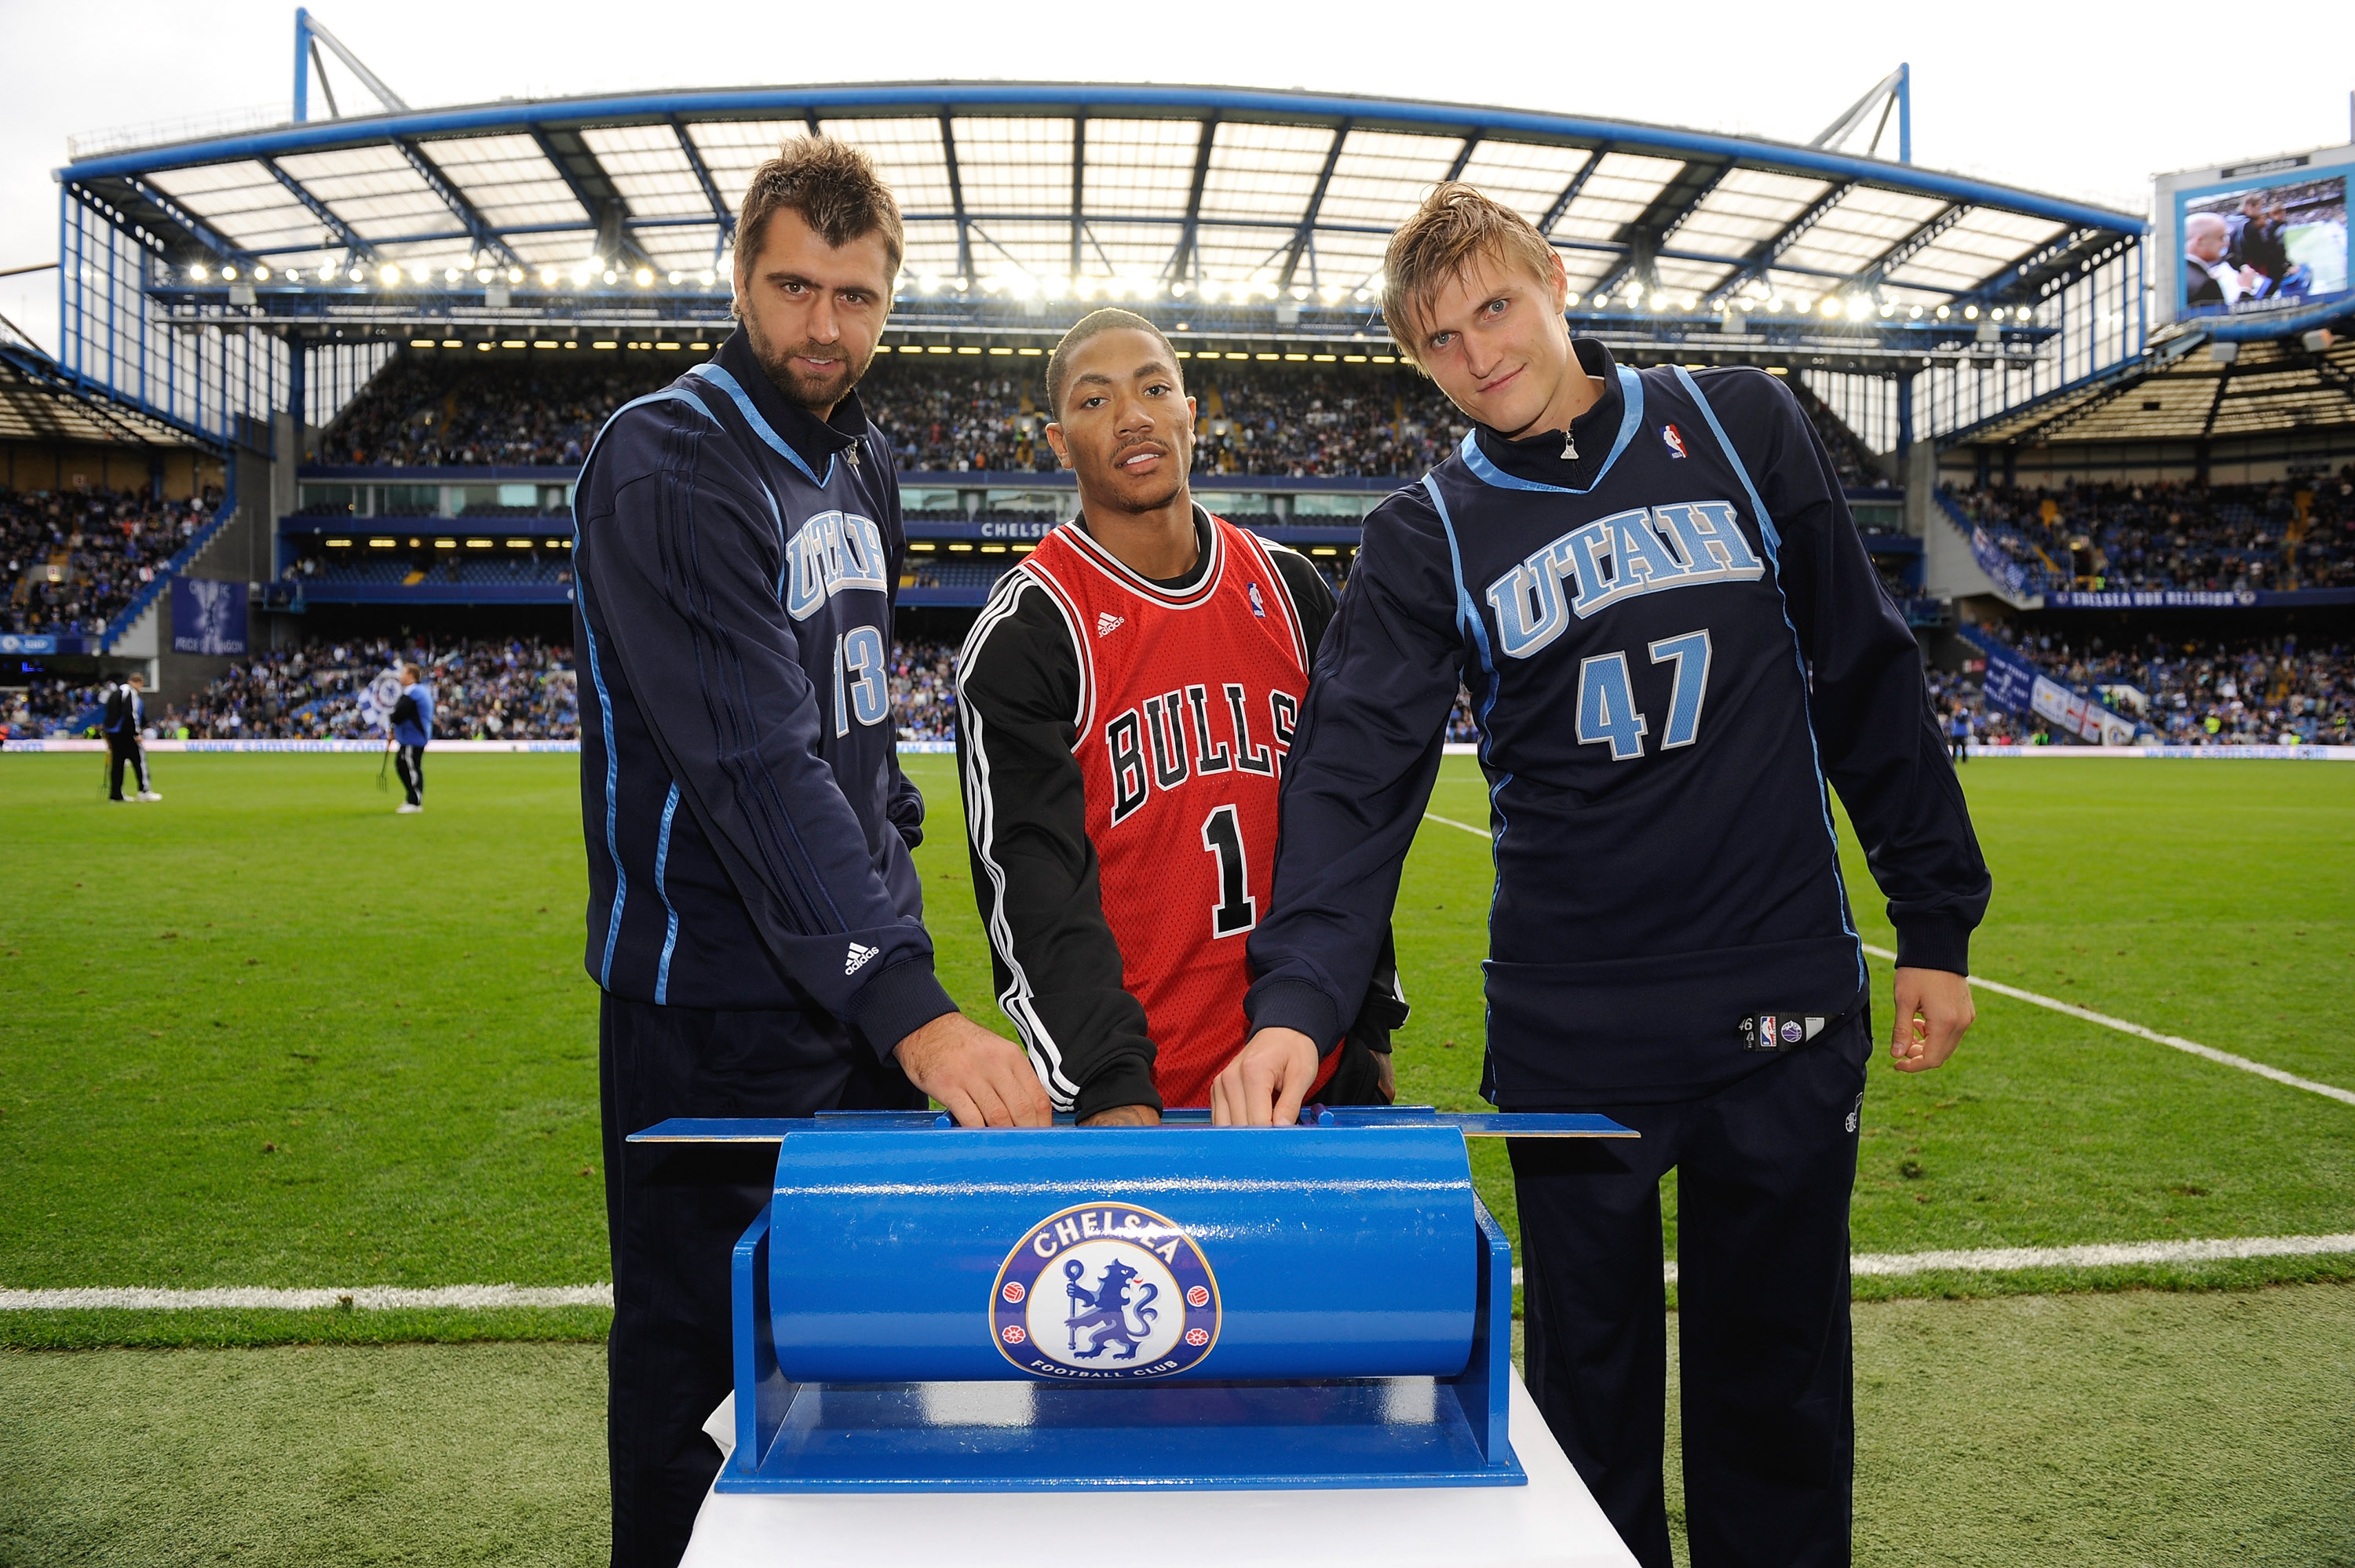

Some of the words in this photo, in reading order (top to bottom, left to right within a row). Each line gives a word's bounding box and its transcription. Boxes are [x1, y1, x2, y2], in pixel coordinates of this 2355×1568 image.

[786, 510, 888, 622] UTAH
[981, 523, 1061, 538] CHELSE
[1486, 501, 1766, 659] UTAH
[834, 625, 889, 739] 13
[1575, 629, 1713, 761] 47
[1105, 683, 1298, 830] BULLS
[1201, 804, 1256, 940] 1
[845, 946, 879, 975] adidas
[1738, 1017, 1753, 1031] 46
[1033, 1211, 1180, 1266] CHELSEA
[1030, 1358, 1124, 1378] FOOTBALL
[1133, 1359, 1179, 1377] CLUB
